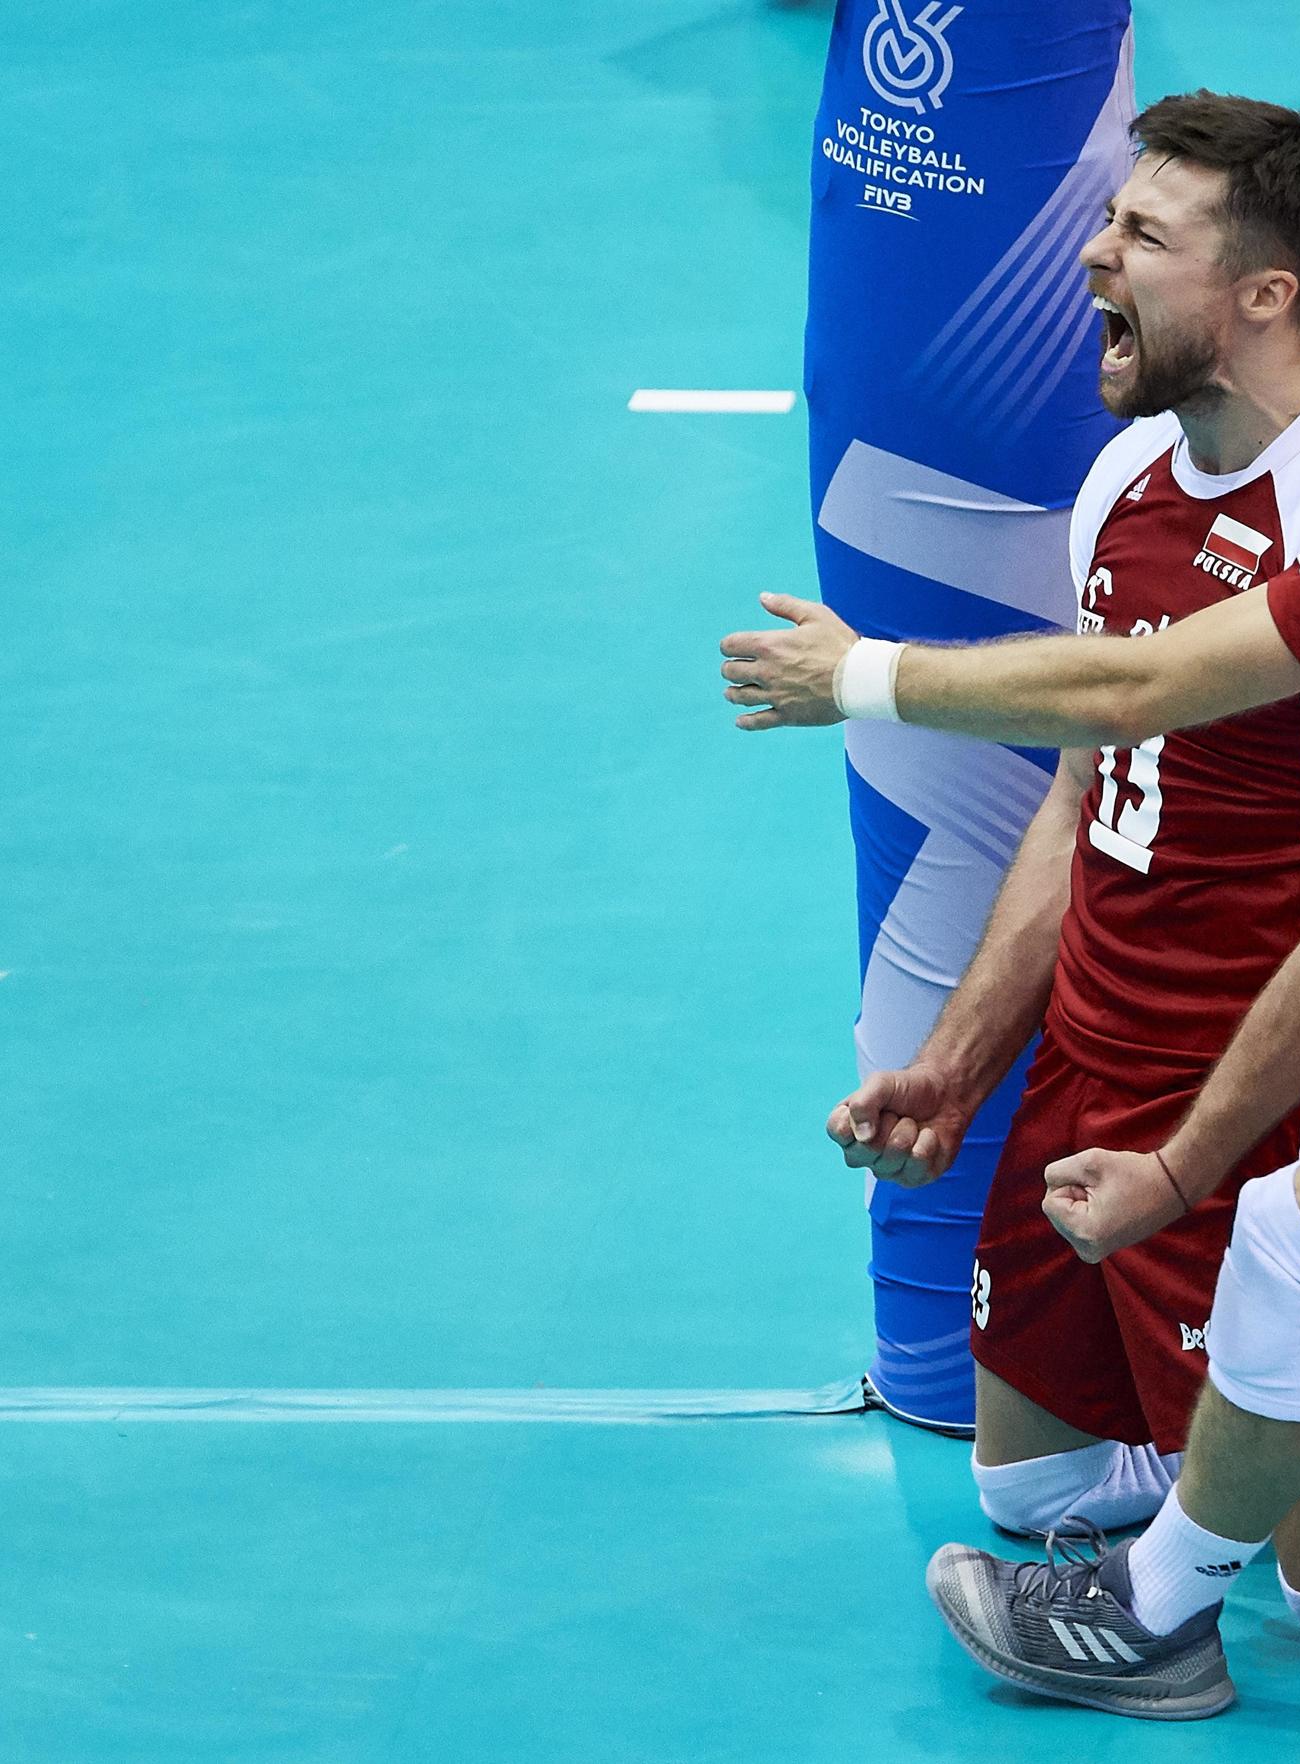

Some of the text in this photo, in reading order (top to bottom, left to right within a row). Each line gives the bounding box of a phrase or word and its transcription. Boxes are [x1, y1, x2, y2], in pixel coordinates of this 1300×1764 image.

[836, 119, 967, 171] VOLLEYBALL
[860, 107, 935, 144] TOKYO
[822, 137, 985, 195] QUALIFICATION
[864, 184, 912, 211] FIVB
[1192, 551, 1253, 591] POLSKA
